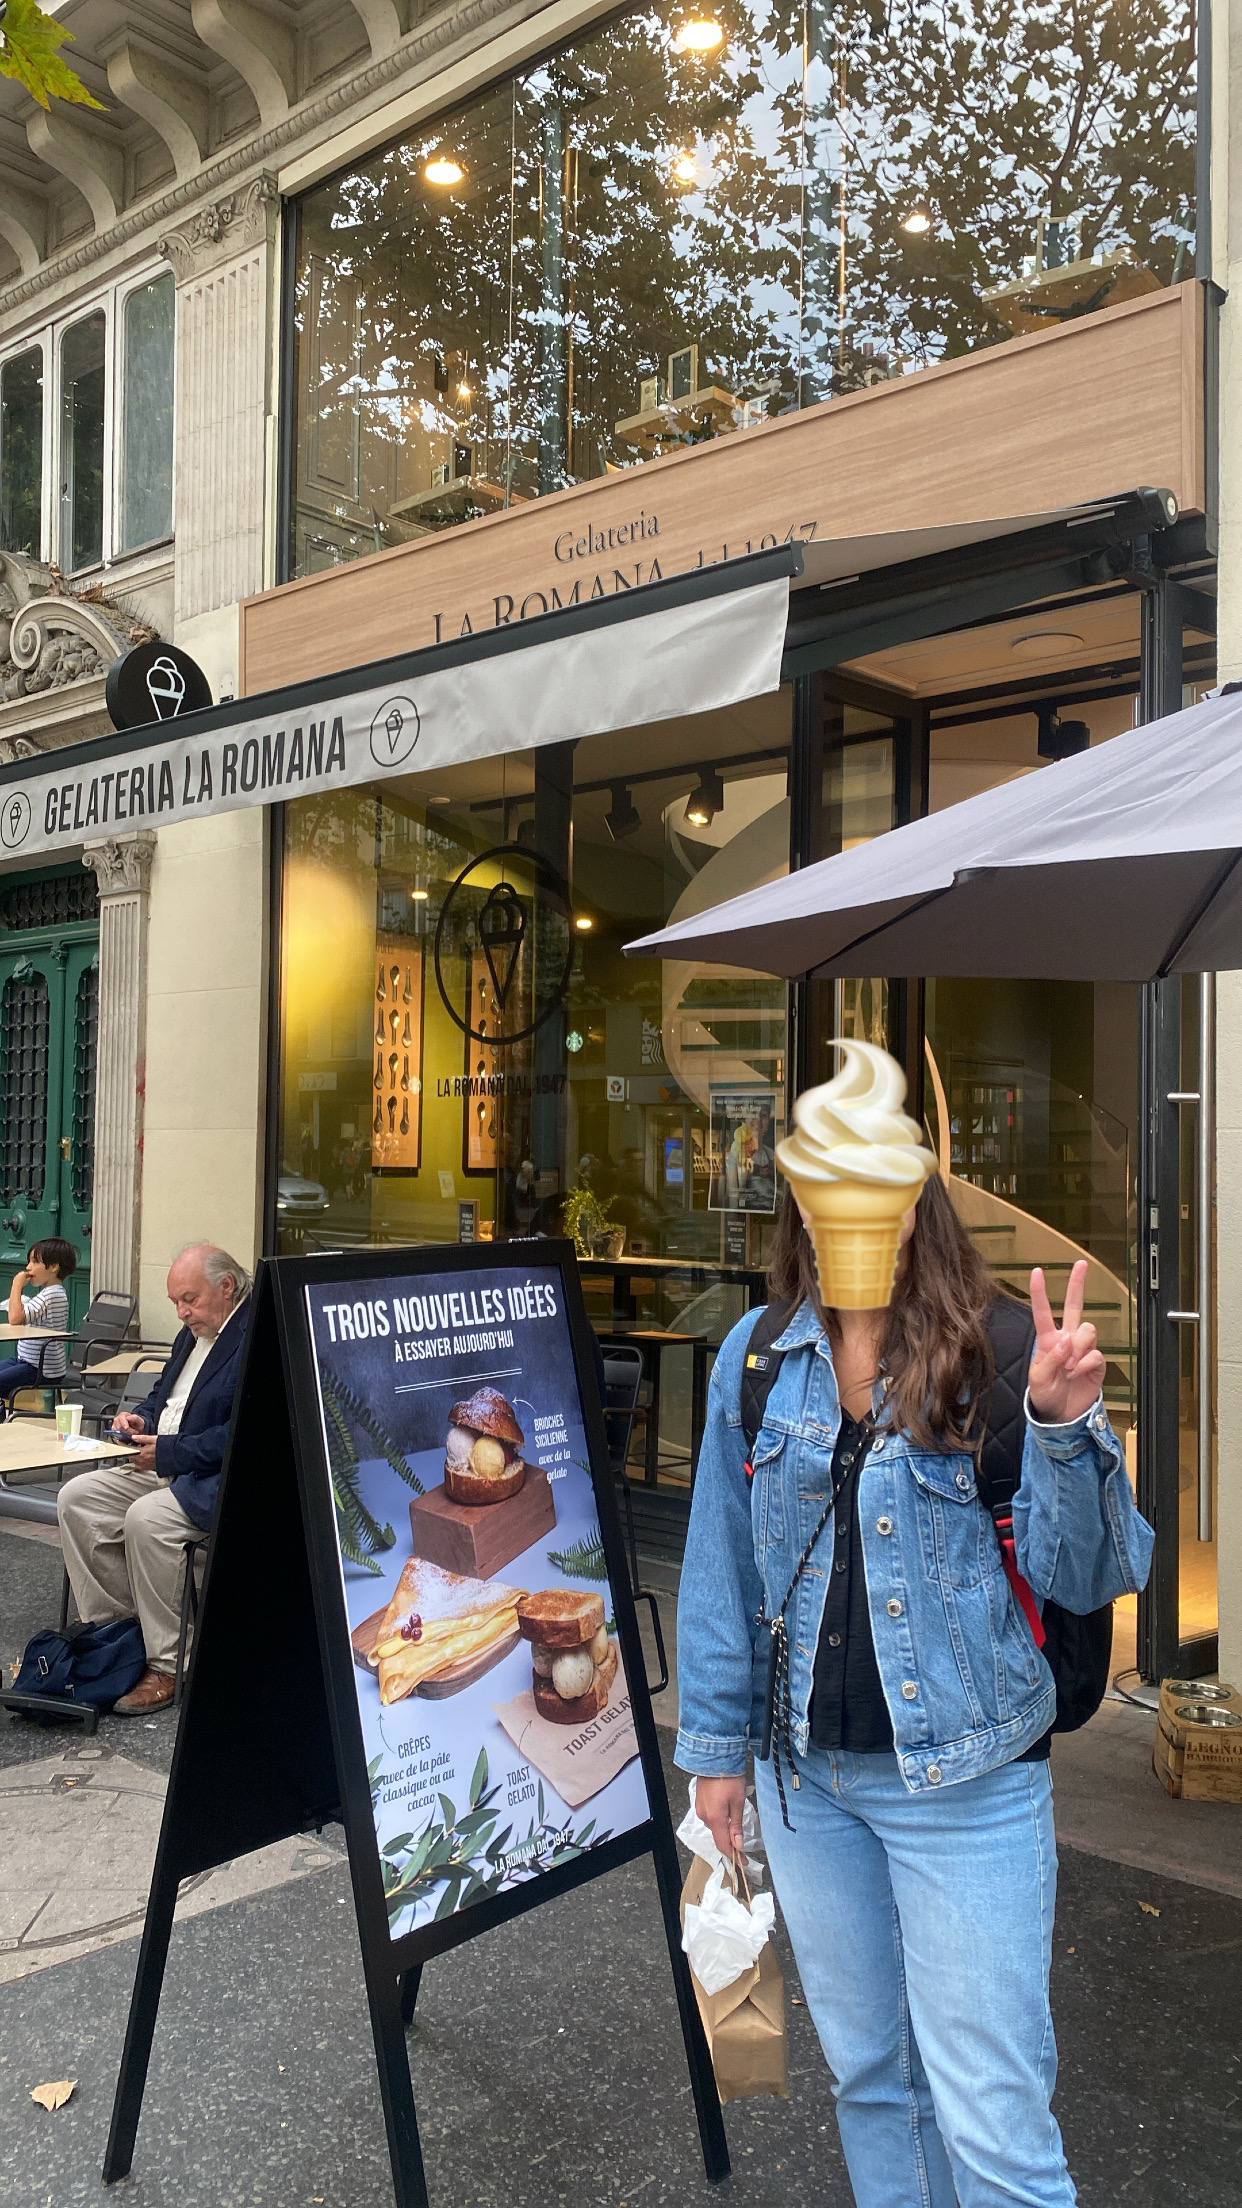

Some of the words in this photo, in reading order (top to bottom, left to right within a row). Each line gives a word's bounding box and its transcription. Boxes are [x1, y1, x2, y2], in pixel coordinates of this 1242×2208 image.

[554, 510, 661, 563] Gelateria
[492, 558, 664, 627] ROMANA
[44, 759, 175, 836] GELATERIA
[182, 750, 214, 806] LA
[221, 716, 346, 797] ROMANA
[437, 1078, 451, 1098] LA
[454, 1077, 505, 1098] ROMANA
[322, 1300, 391, 1342] TROIS
[393, 1288, 506, 1334] NOUVELLES
[508, 1280, 558, 1321] IDÉES
[394, 1340, 403, 1363] À
[405, 1337, 452, 1362] ESSAYER
[453, 1329, 515, 1355] AUJOURD'HUI
[534, 1414, 565, 1431] BRIOCHES
[535, 1430, 568, 1449] SICILIENNE
[538, 1453, 553, 1465] avec
[555, 1450, 563, 1461] de
[563, 1448, 571, 1459] la
[546, 1467, 568, 1485] gelato
[563, 1721, 602, 1756] TOAST
[600, 1695, 632, 1723] GELAT
[397, 1735, 431, 1759] CRÊPES
[382, 1769, 405, 1785] avec
[406, 1763, 418, 1778] de
[419, 1759, 430, 1773] la
[506, 1766, 531, 1787] TOAST
[382, 1779, 428, 1804] classique
[429, 1773, 441, 1786] ou
[442, 1768, 455, 1781] au
[507, 1783, 536, 1807] GELATO
[407, 1793, 436, 1812] cacao
[494, 1858, 506, 1874] LA
[505, 1842, 537, 1869] ROMANA
